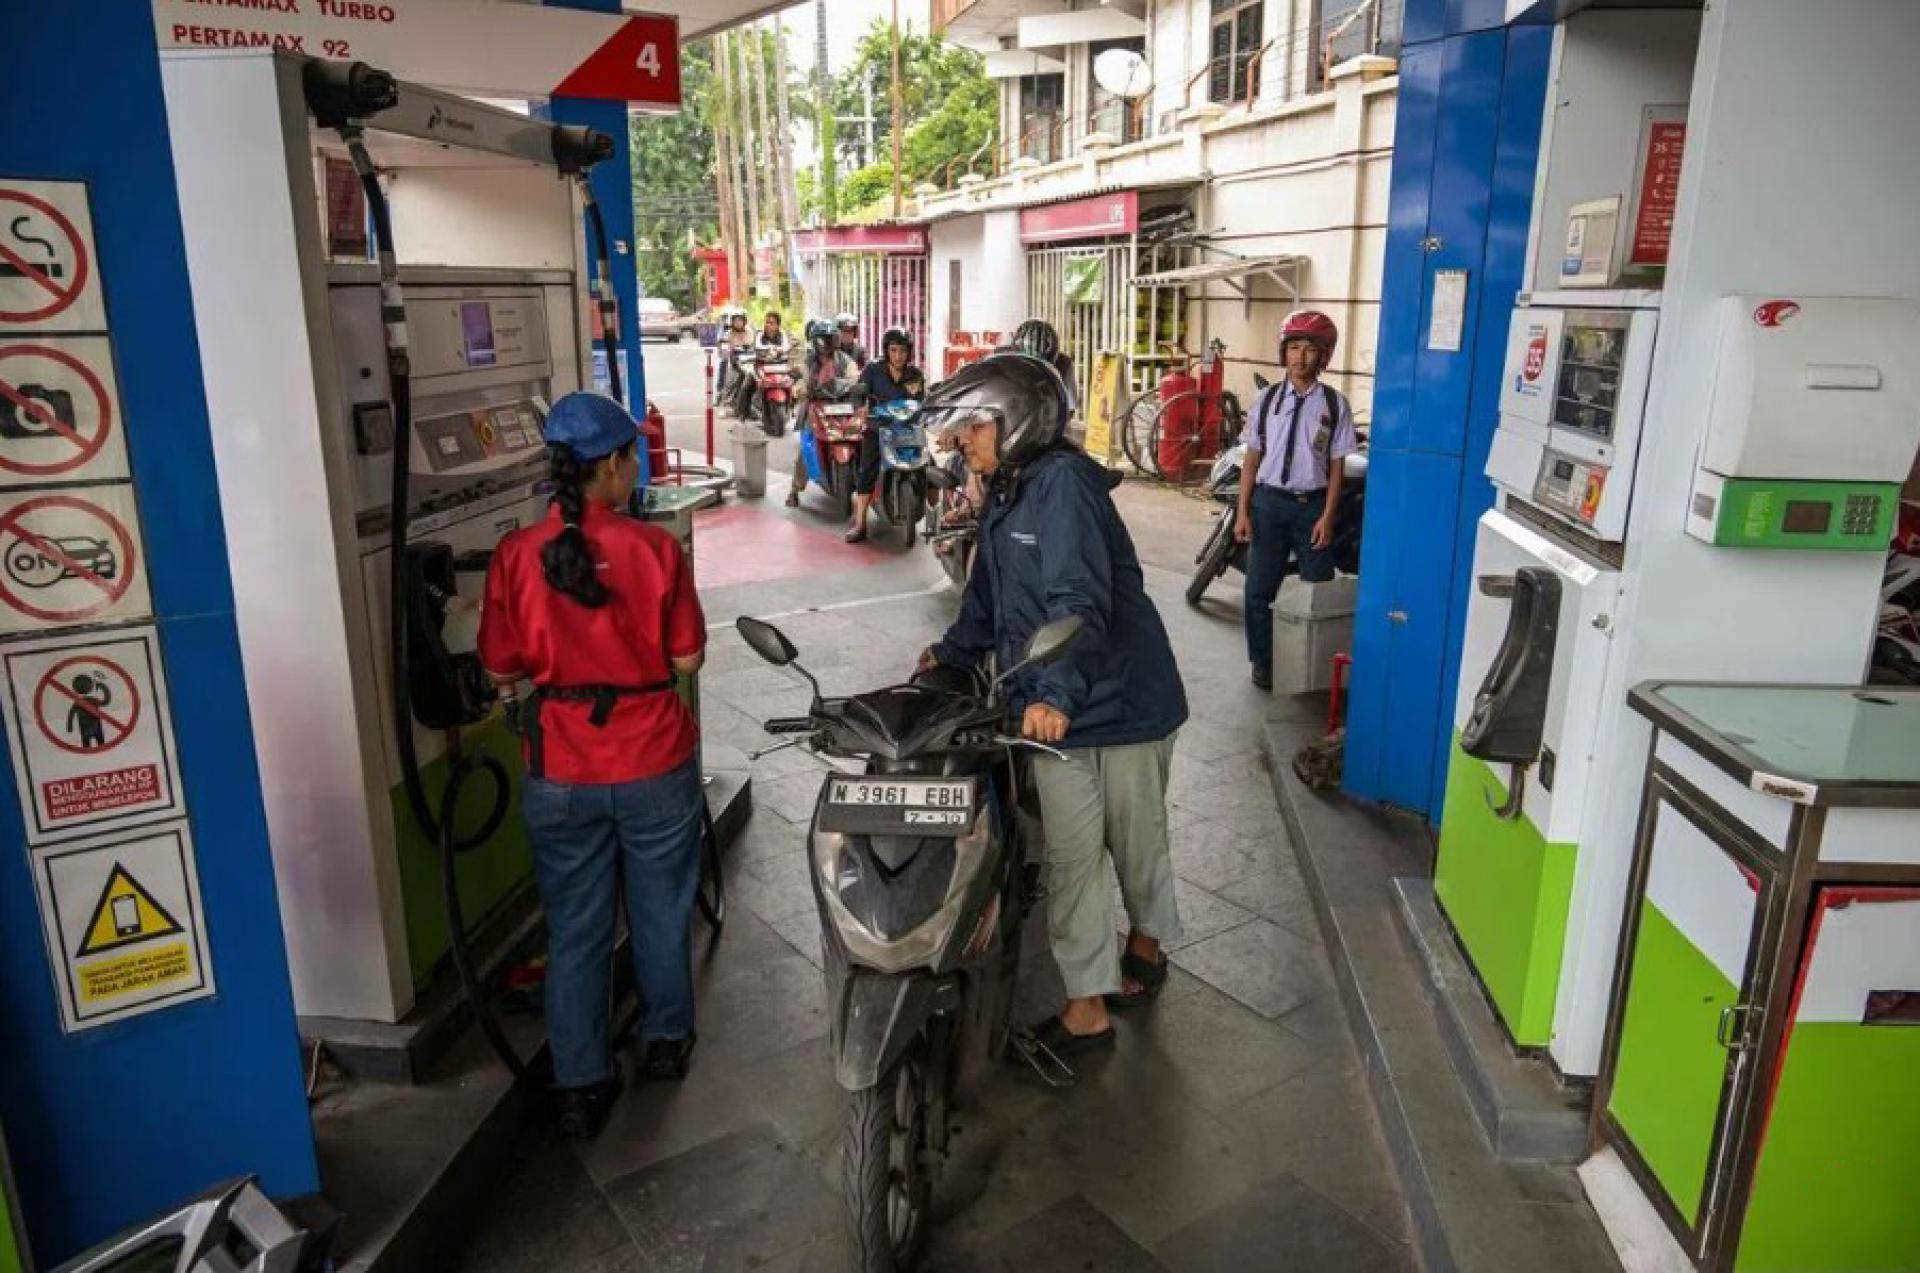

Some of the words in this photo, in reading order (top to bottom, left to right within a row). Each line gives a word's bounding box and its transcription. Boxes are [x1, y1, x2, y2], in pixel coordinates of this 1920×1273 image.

[316, 0, 395, 22] TURBO
[173, 24, 304, 52] PERTAMAX
[322, 38, 350, 57] 92
[636, 42, 661, 77] 4
[48, 768, 152, 797] DILARANG
[857, 784, 907, 804] 3961
[926, 787, 964, 806] EBH
